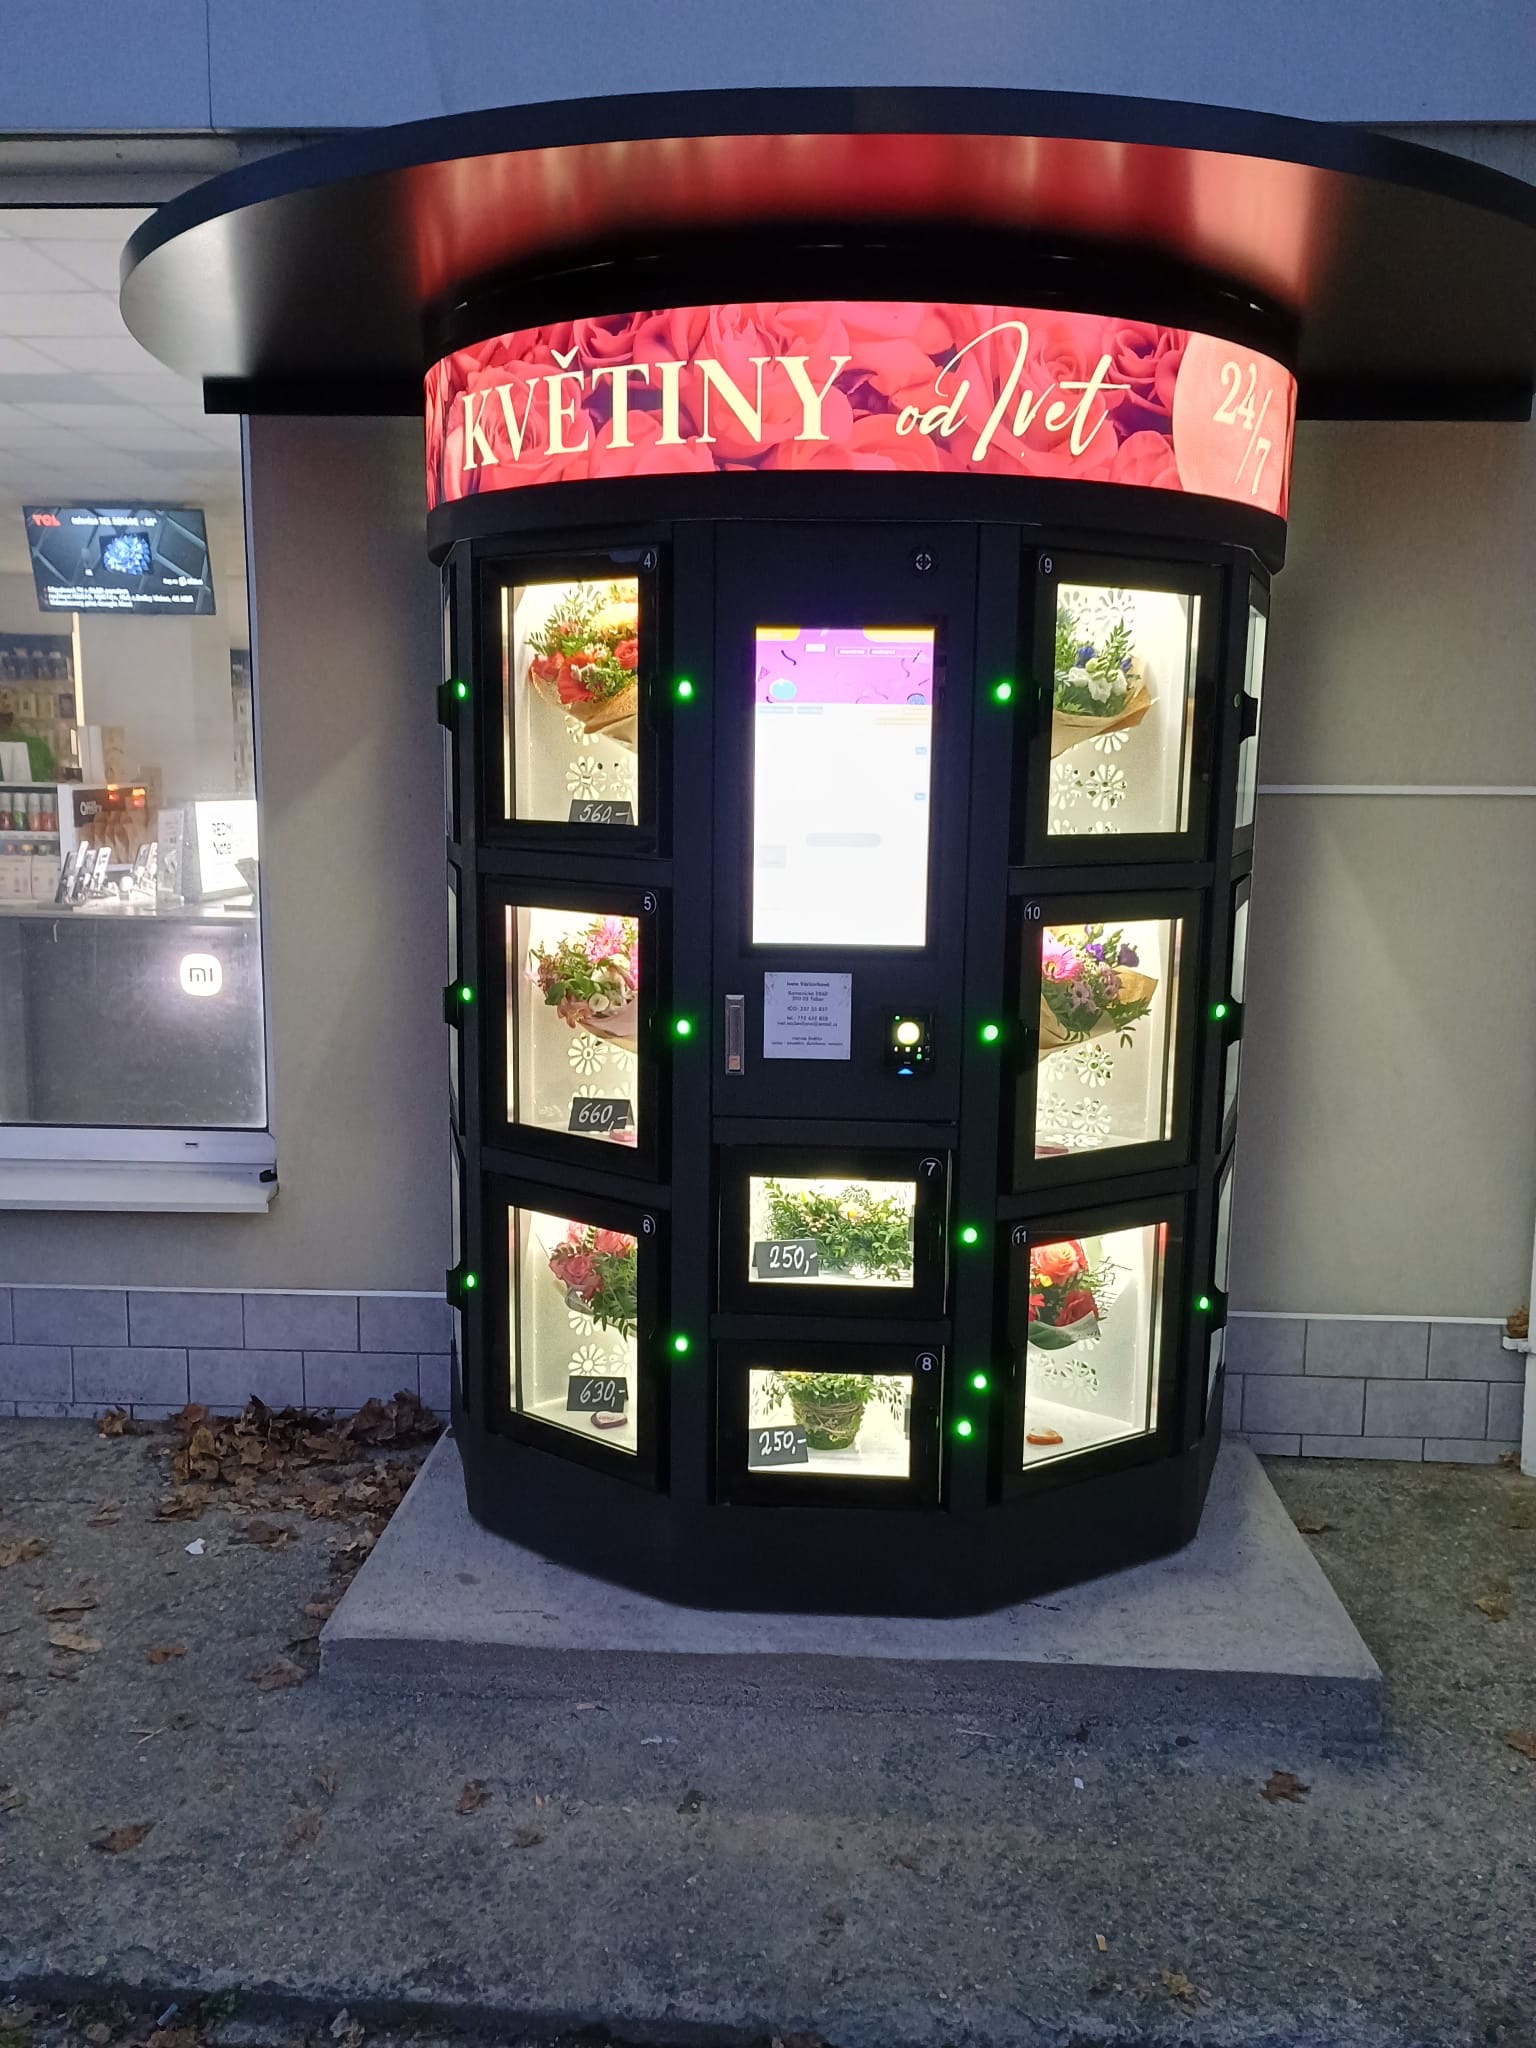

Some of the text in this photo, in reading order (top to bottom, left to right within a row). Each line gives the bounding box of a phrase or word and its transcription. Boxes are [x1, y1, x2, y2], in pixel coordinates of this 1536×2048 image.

[461, 320, 1131, 472] KVĚTINY od Ivet
[32, 514, 61, 527] TCL
[643, 552, 651, 568] 4
[1044, 557, 1053, 574] 9
[643, 896, 652, 911] 5
[1027, 906, 1041, 921] 10
[926, 1162, 936, 1177] 7
[643, 1219, 651, 1233] 6
[1015, 1231, 1027, 1245] 11
[922, 1357, 932, 1371] 8
